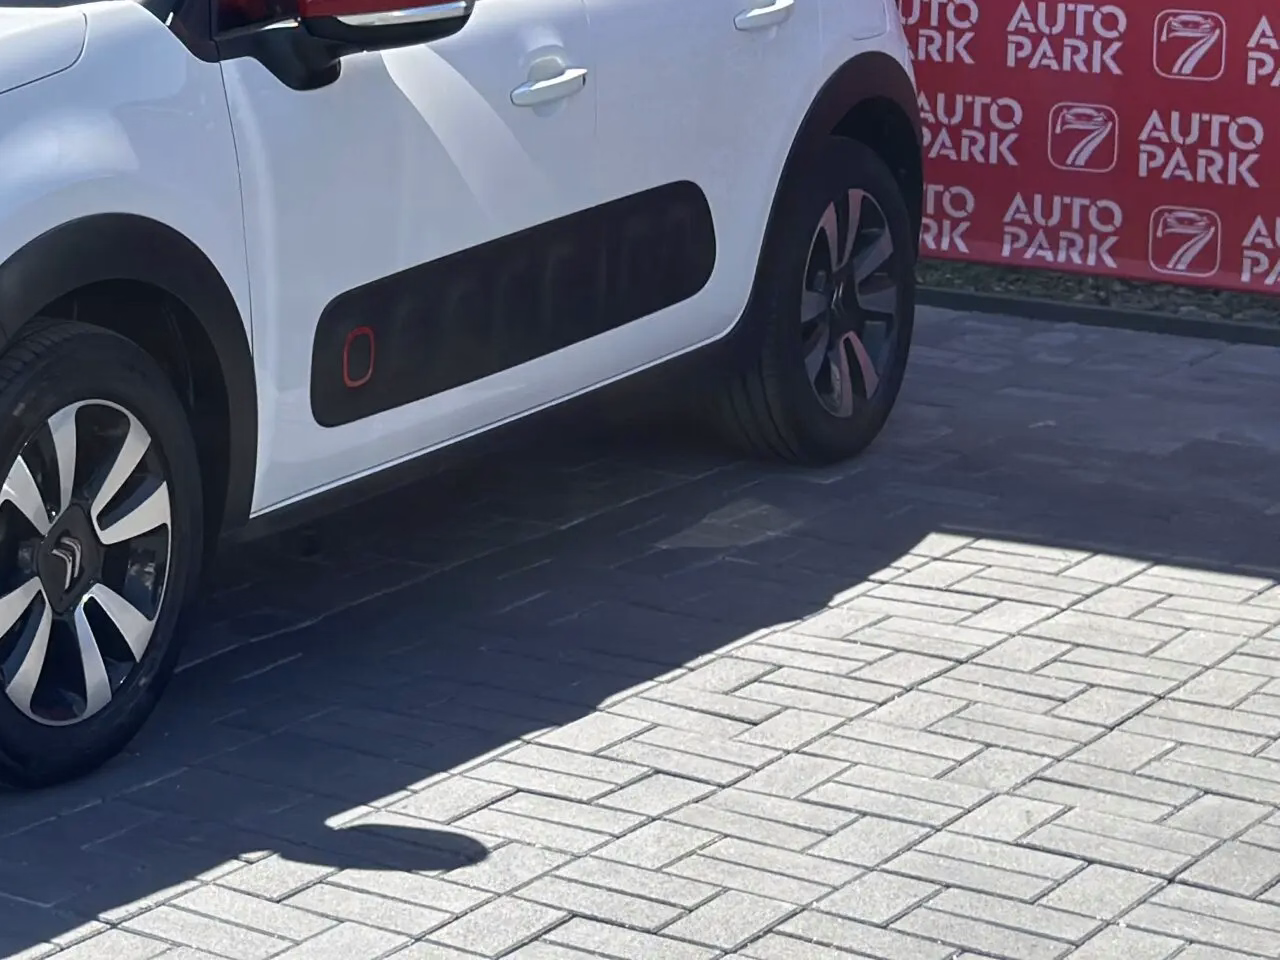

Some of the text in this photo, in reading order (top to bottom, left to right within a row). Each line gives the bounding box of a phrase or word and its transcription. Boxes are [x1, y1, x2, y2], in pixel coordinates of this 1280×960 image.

[1007, 0, 1127, 38] AUTO
[1007, 35, 1122, 74] PARK
[1138, 110, 1264, 150] AUTO
[1139, 144, 1260, 187] PARK
[1004, 192, 1122, 232] AUTO
[1002, 226, 1118, 268] PARK
